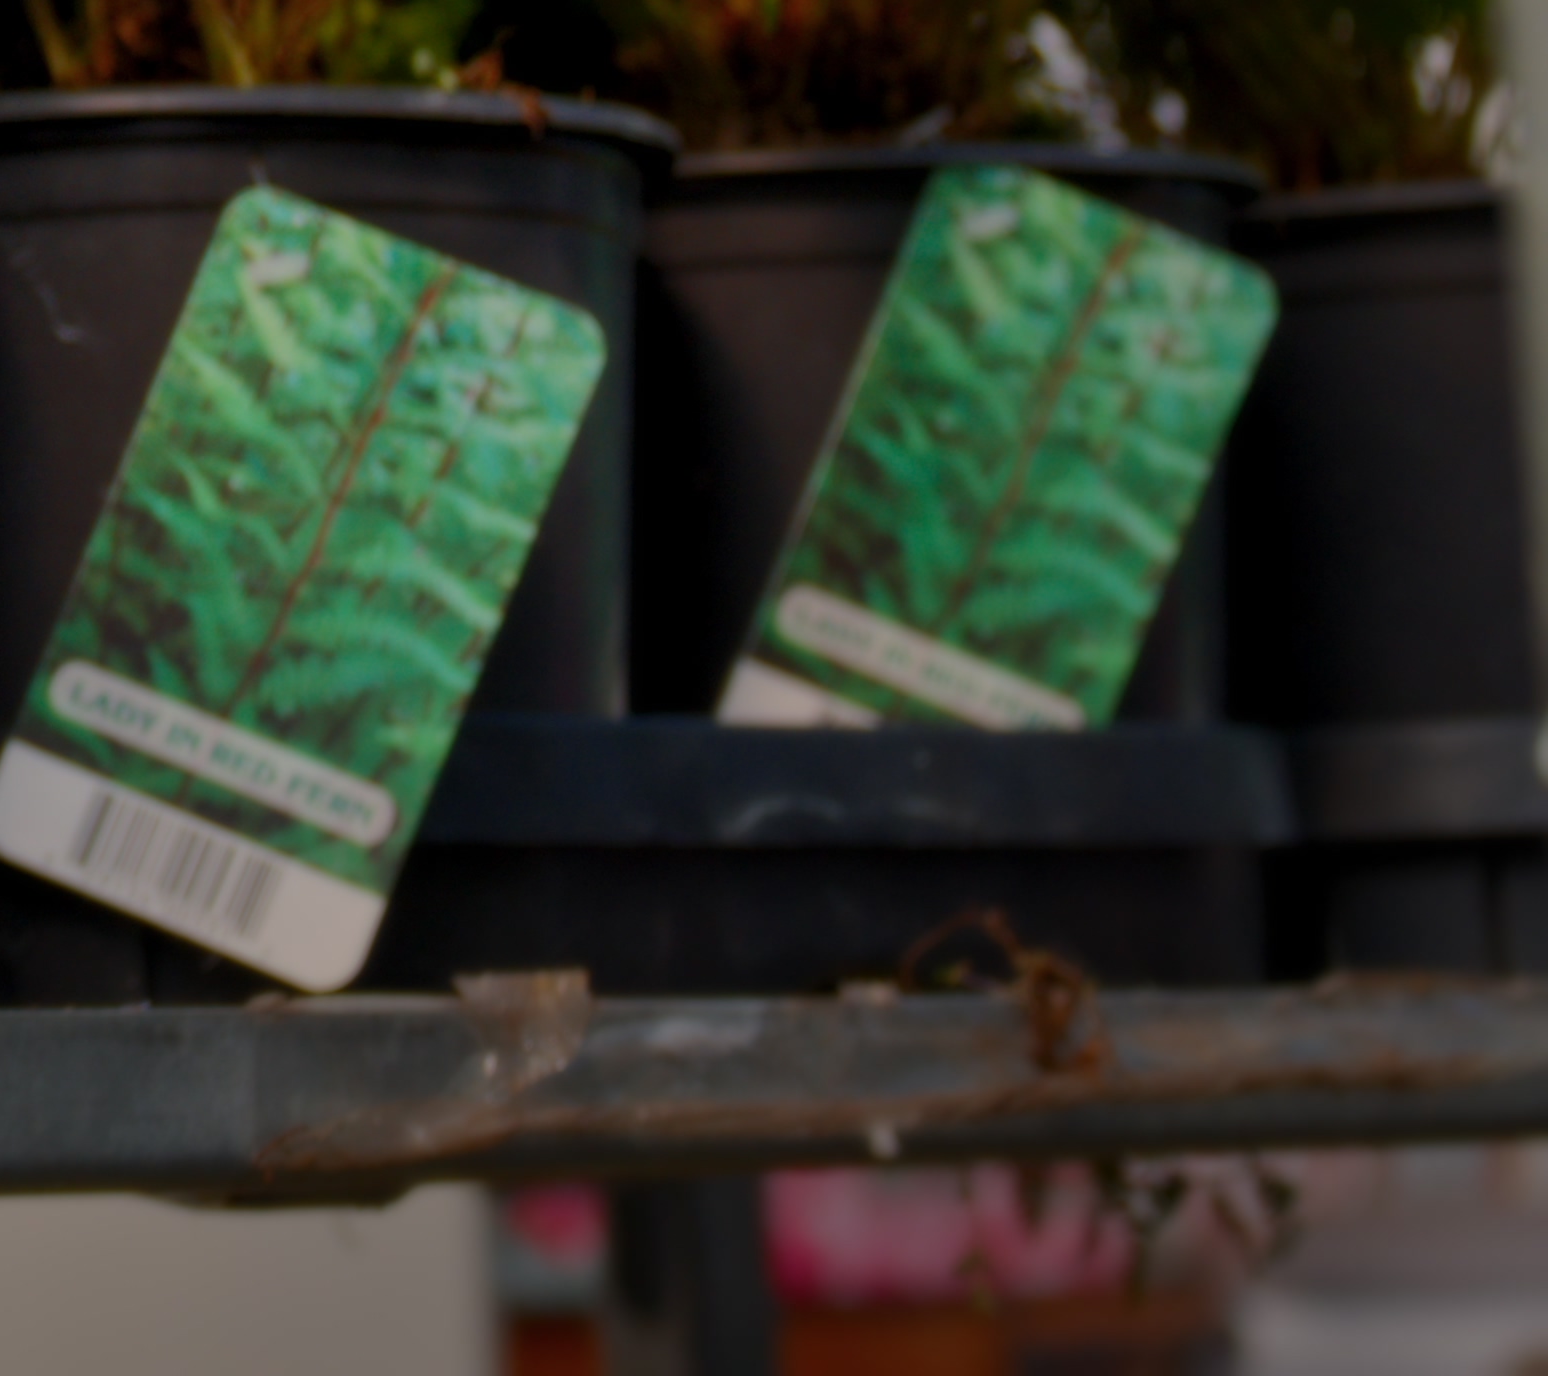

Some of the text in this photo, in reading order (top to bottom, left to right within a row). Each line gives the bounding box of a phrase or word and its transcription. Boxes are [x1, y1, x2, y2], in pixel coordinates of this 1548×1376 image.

[69, 677, 157, 733] LADY
[165, 720, 203, 755] IN
[209, 741, 278, 787] RED
